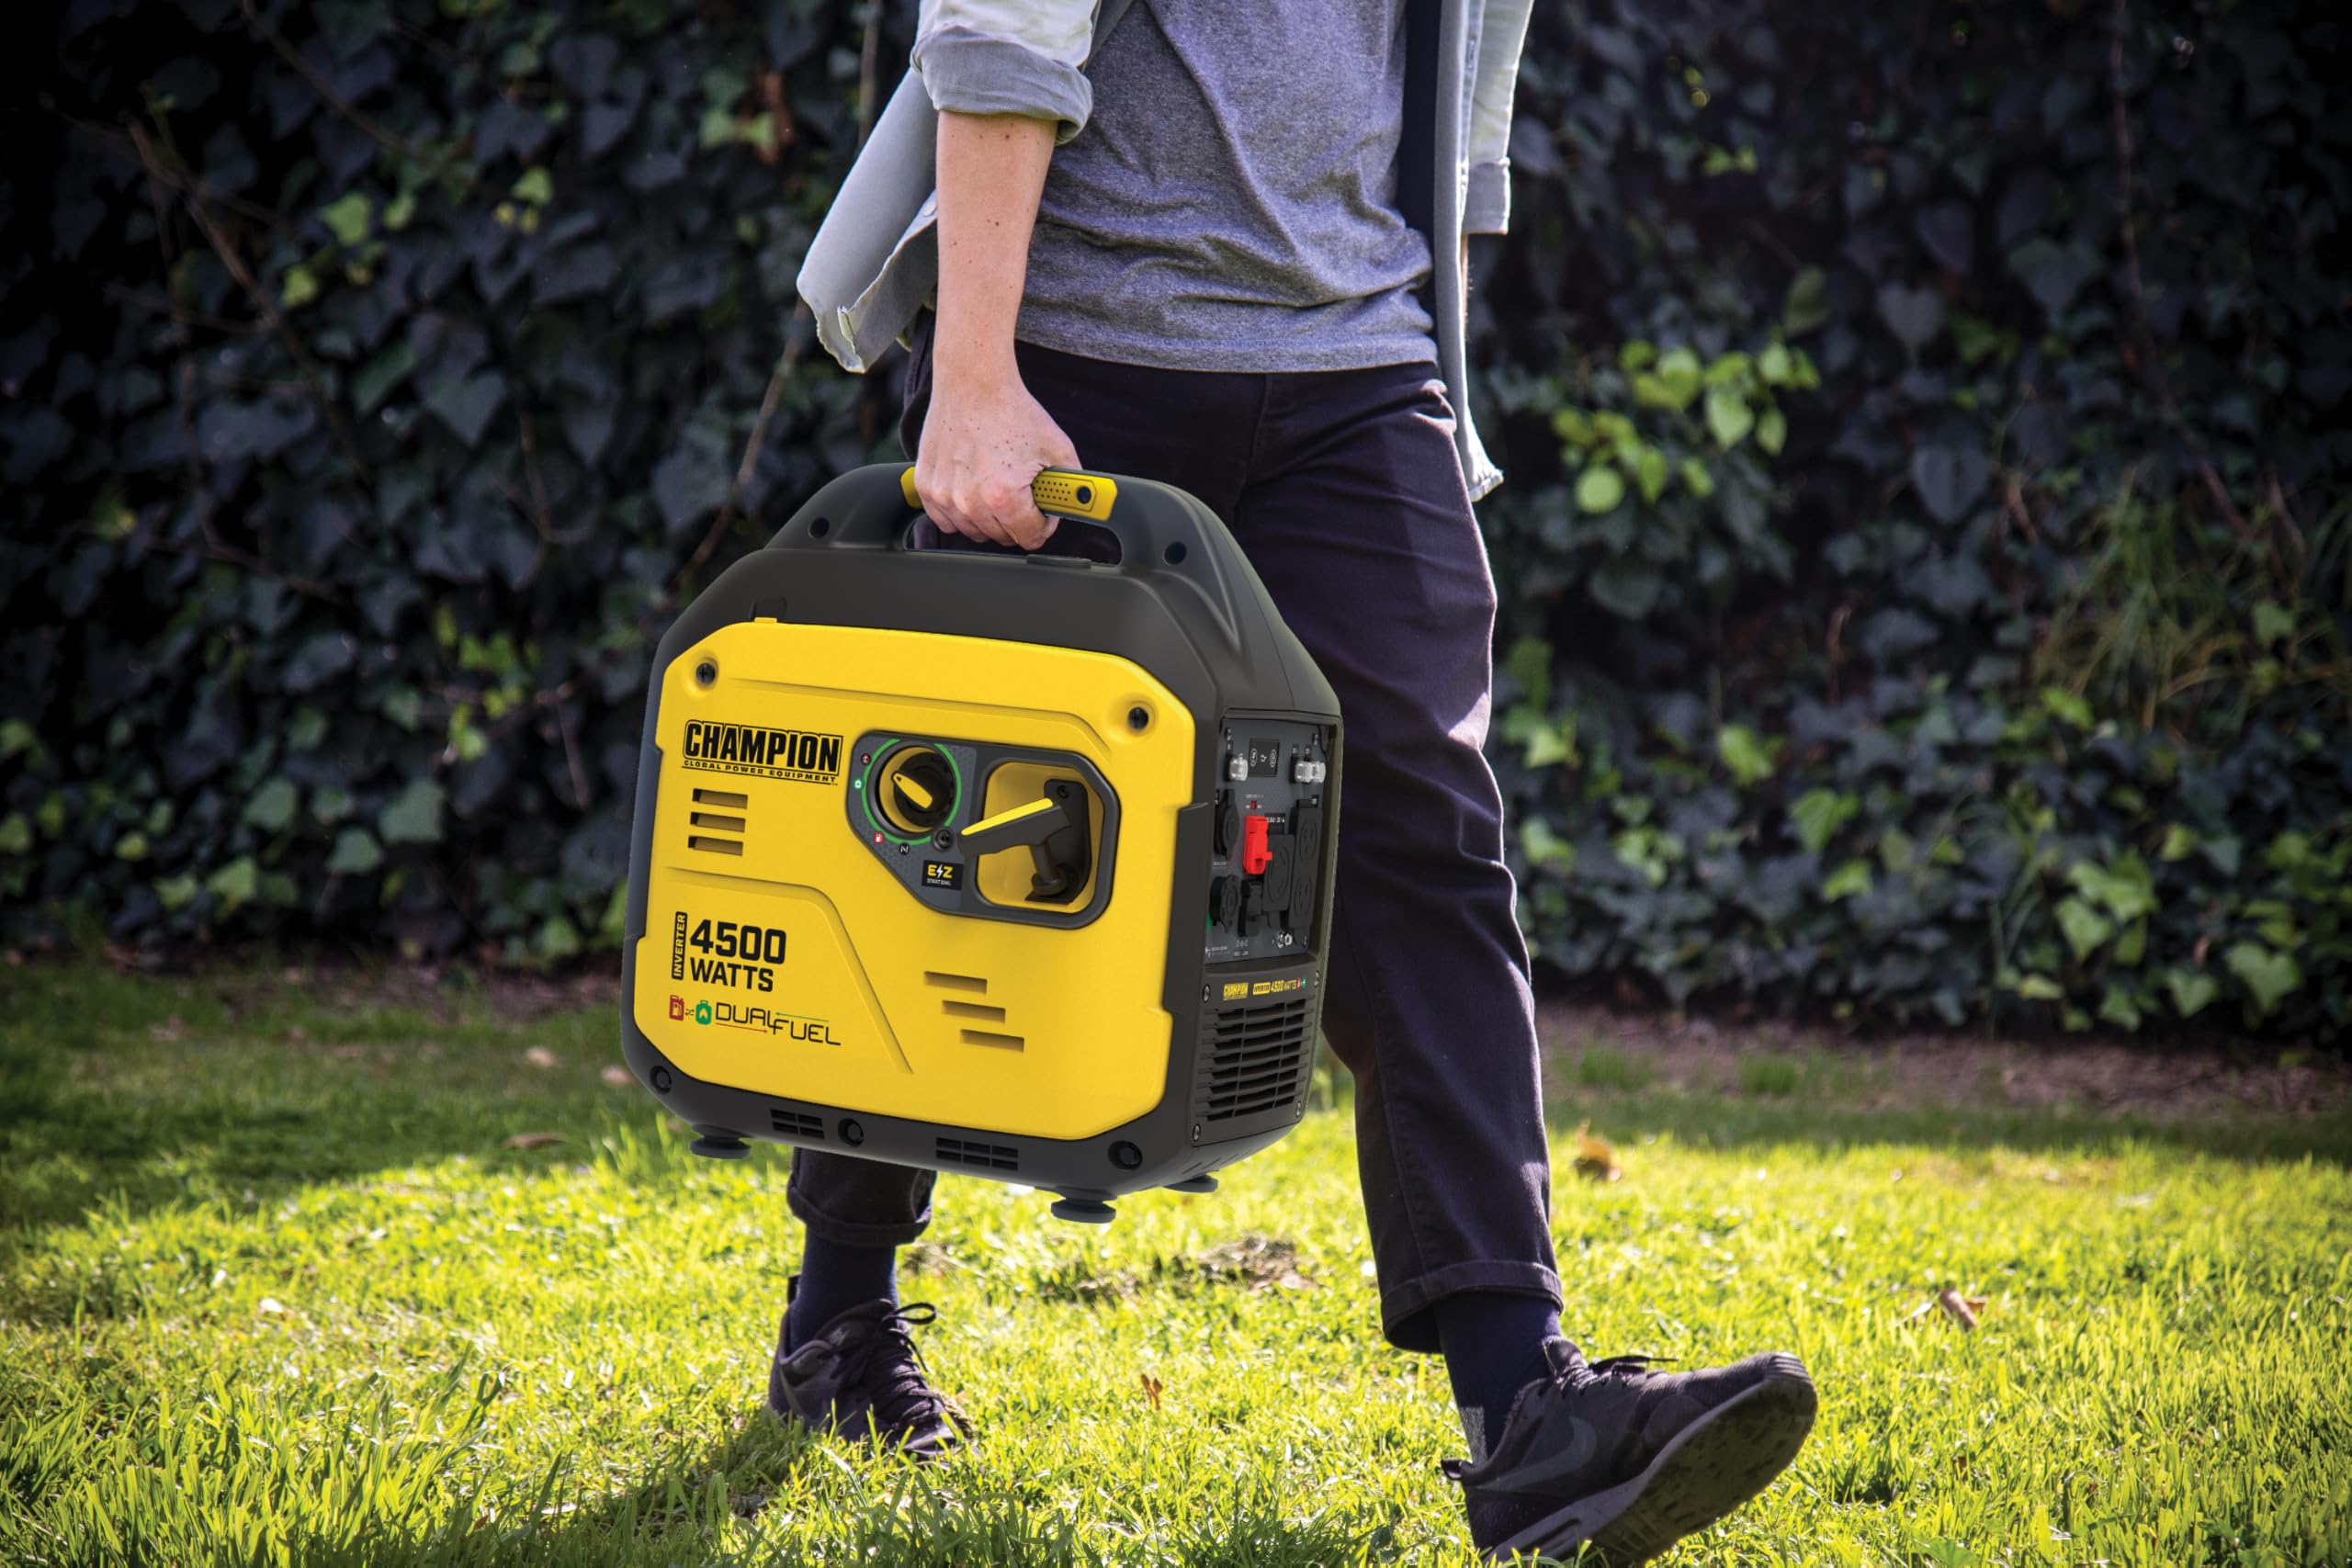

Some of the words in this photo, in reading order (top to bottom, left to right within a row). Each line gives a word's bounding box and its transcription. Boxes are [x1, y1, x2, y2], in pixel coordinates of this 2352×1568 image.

[684, 722, 841, 773] CHAMPION
[684, 760, 721, 770] GLOBAL
[725, 764, 764, 774] POWER
[769, 770, 836, 783] EQUIPMENT
[673, 913, 687, 978] INVERTER
[690, 919, 786, 964] 4500
[690, 956, 774, 992] WATTS
